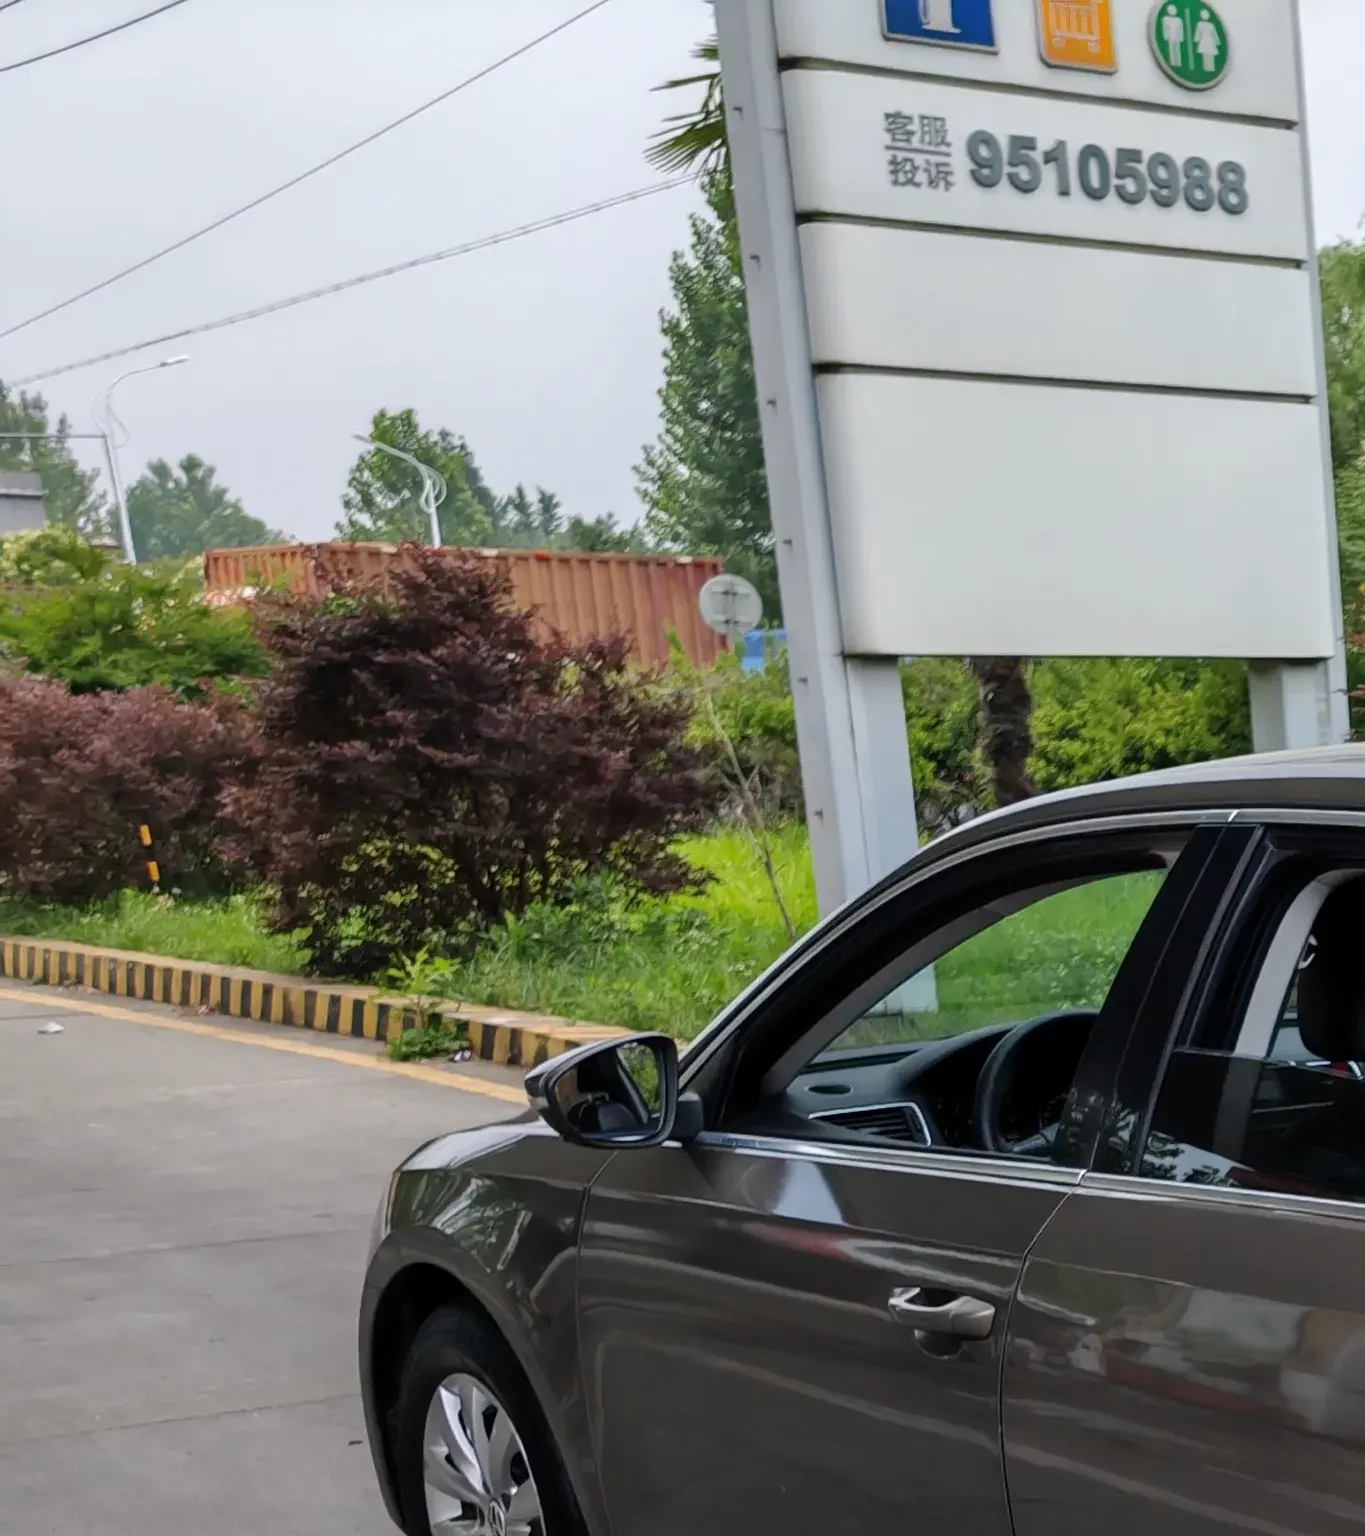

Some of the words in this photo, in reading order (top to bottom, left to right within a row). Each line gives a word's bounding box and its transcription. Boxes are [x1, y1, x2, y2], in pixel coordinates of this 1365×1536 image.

[884, 110, 953, 148] 客服
[888, 154, 956, 192] 投诉
[966, 128, 1249, 215] 95105988
